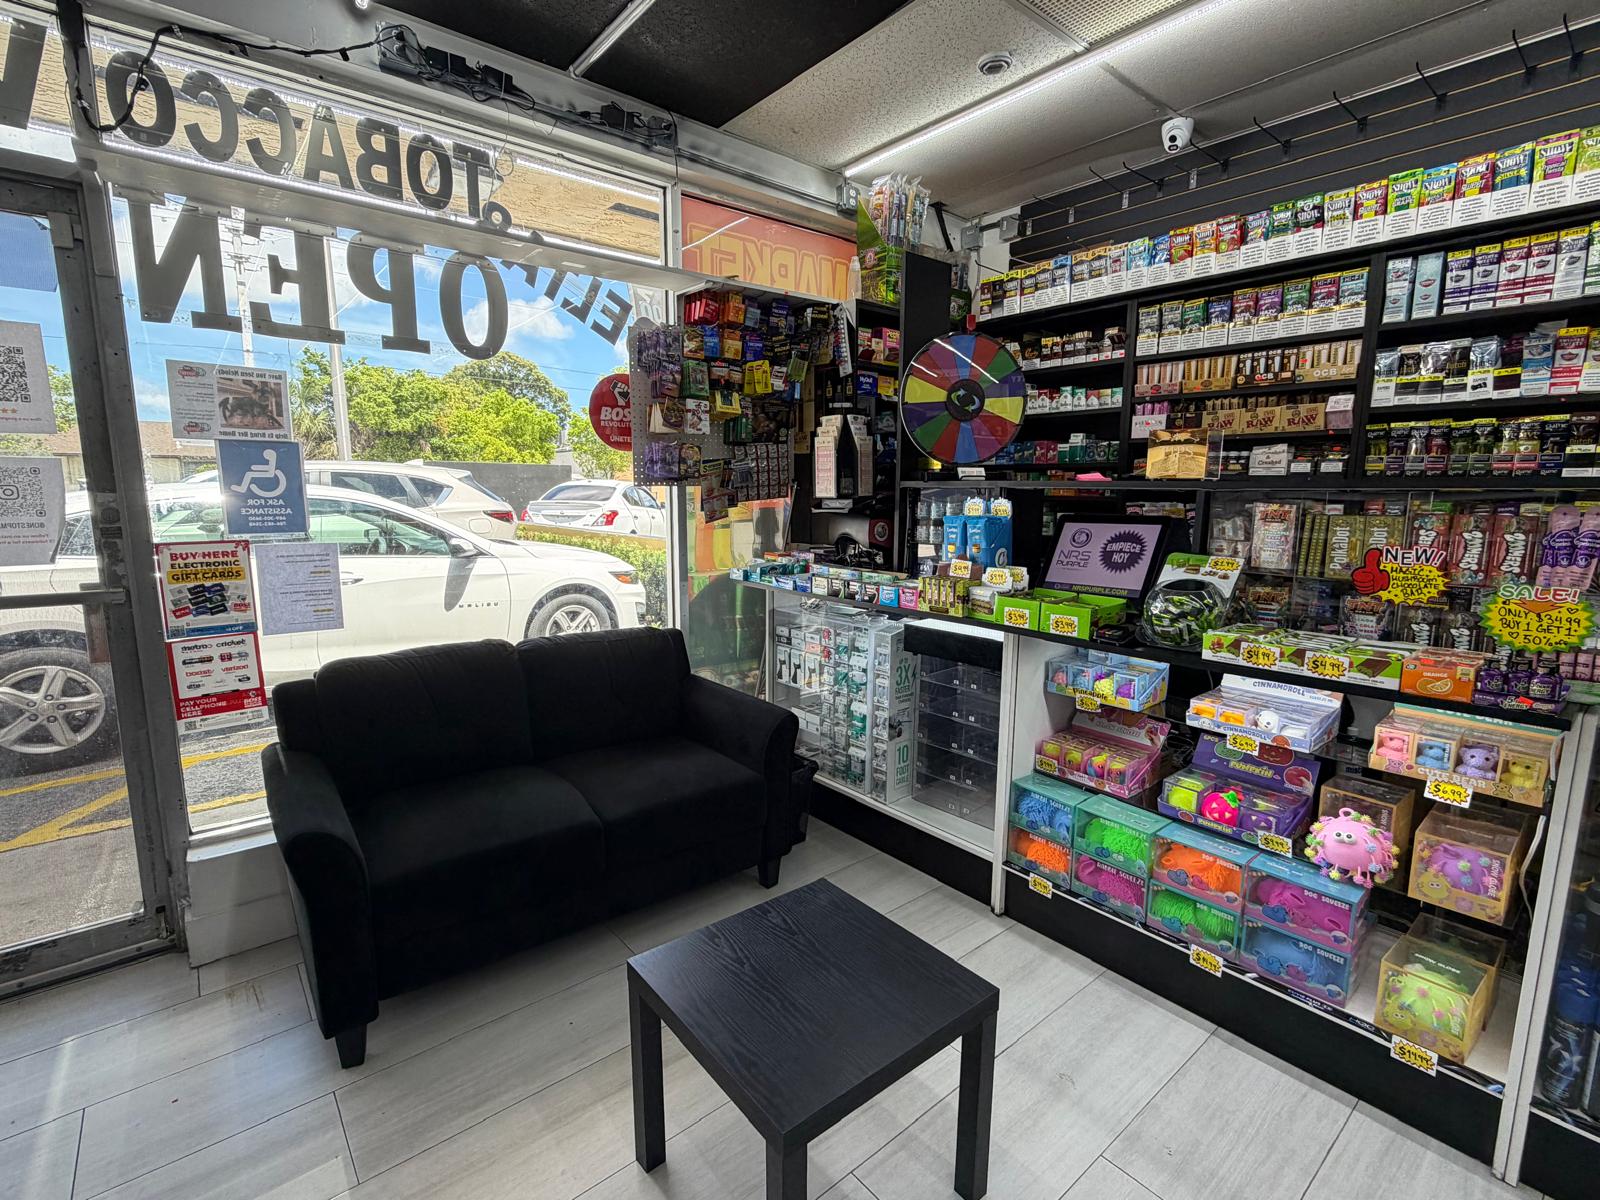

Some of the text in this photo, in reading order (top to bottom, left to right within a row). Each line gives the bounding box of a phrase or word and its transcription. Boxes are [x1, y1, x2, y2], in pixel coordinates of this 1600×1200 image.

[1313, 368, 1337, 377] OCB
[1208, 419, 1234, 430] RAW
[1246, 416, 1274, 428] RAW
[1287, 413, 1318, 426] RAW
[1106, 542, 1141, 553] EMPIECE
[1330, 526, 1350, 569] PolkaDot
[169, 550, 239, 562] BUY HERE
[1058, 550, 1091, 561] NRS
[1111, 552, 1130, 564] HOY
[1384, 546, 1446, 567] NEW!
[170, 560, 240, 570] ELECTRONIC
[1055, 560, 1088, 568] PURPLE
[171, 570, 242, 582] GIFT CARDS
[1390, 567, 1425, 576] MAGIC
[1071, 584, 1128, 596] NRSPURPLE.COM
[1391, 582, 1440, 590] CHOCOLATE
[1402, 589, 1426, 598] BAR
[1500, 583, 1581, 604] SALE!
[1535, 612, 1581, 628] $34.99
[1500, 617, 1574, 637] BUY 1 GET 1
[1522, 634, 1553, 647] 50%
[1246, 648, 1271, 661] $4.99
[1310, 659, 1341, 673] $4.99
[895, 664, 911, 686] 3X
[1072, 688, 1108, 701] Pineapple
[1252, 680, 1306, 697] CINNAMOROLL
[180, 701, 227, 712] CELLPHONE
[195, 697, 217, 705] YOUR
[1222, 726, 1268, 741] CINNAMOROLL
[896, 744, 909, 764] 10
[1229, 760, 1274, 778] PUMPKIN
[1417, 767, 1487, 788] CUTE BEAR
[1433, 785, 1463, 798] $6.99
[1487, 859, 1500, 898] SNOW GLOBE
[1304, 889, 1350, 910] DOG SQUEEZE
[1299, 941, 1345, 964] DOG SQUEEZE
[1398, 1045, 1429, 1064] $14.99
